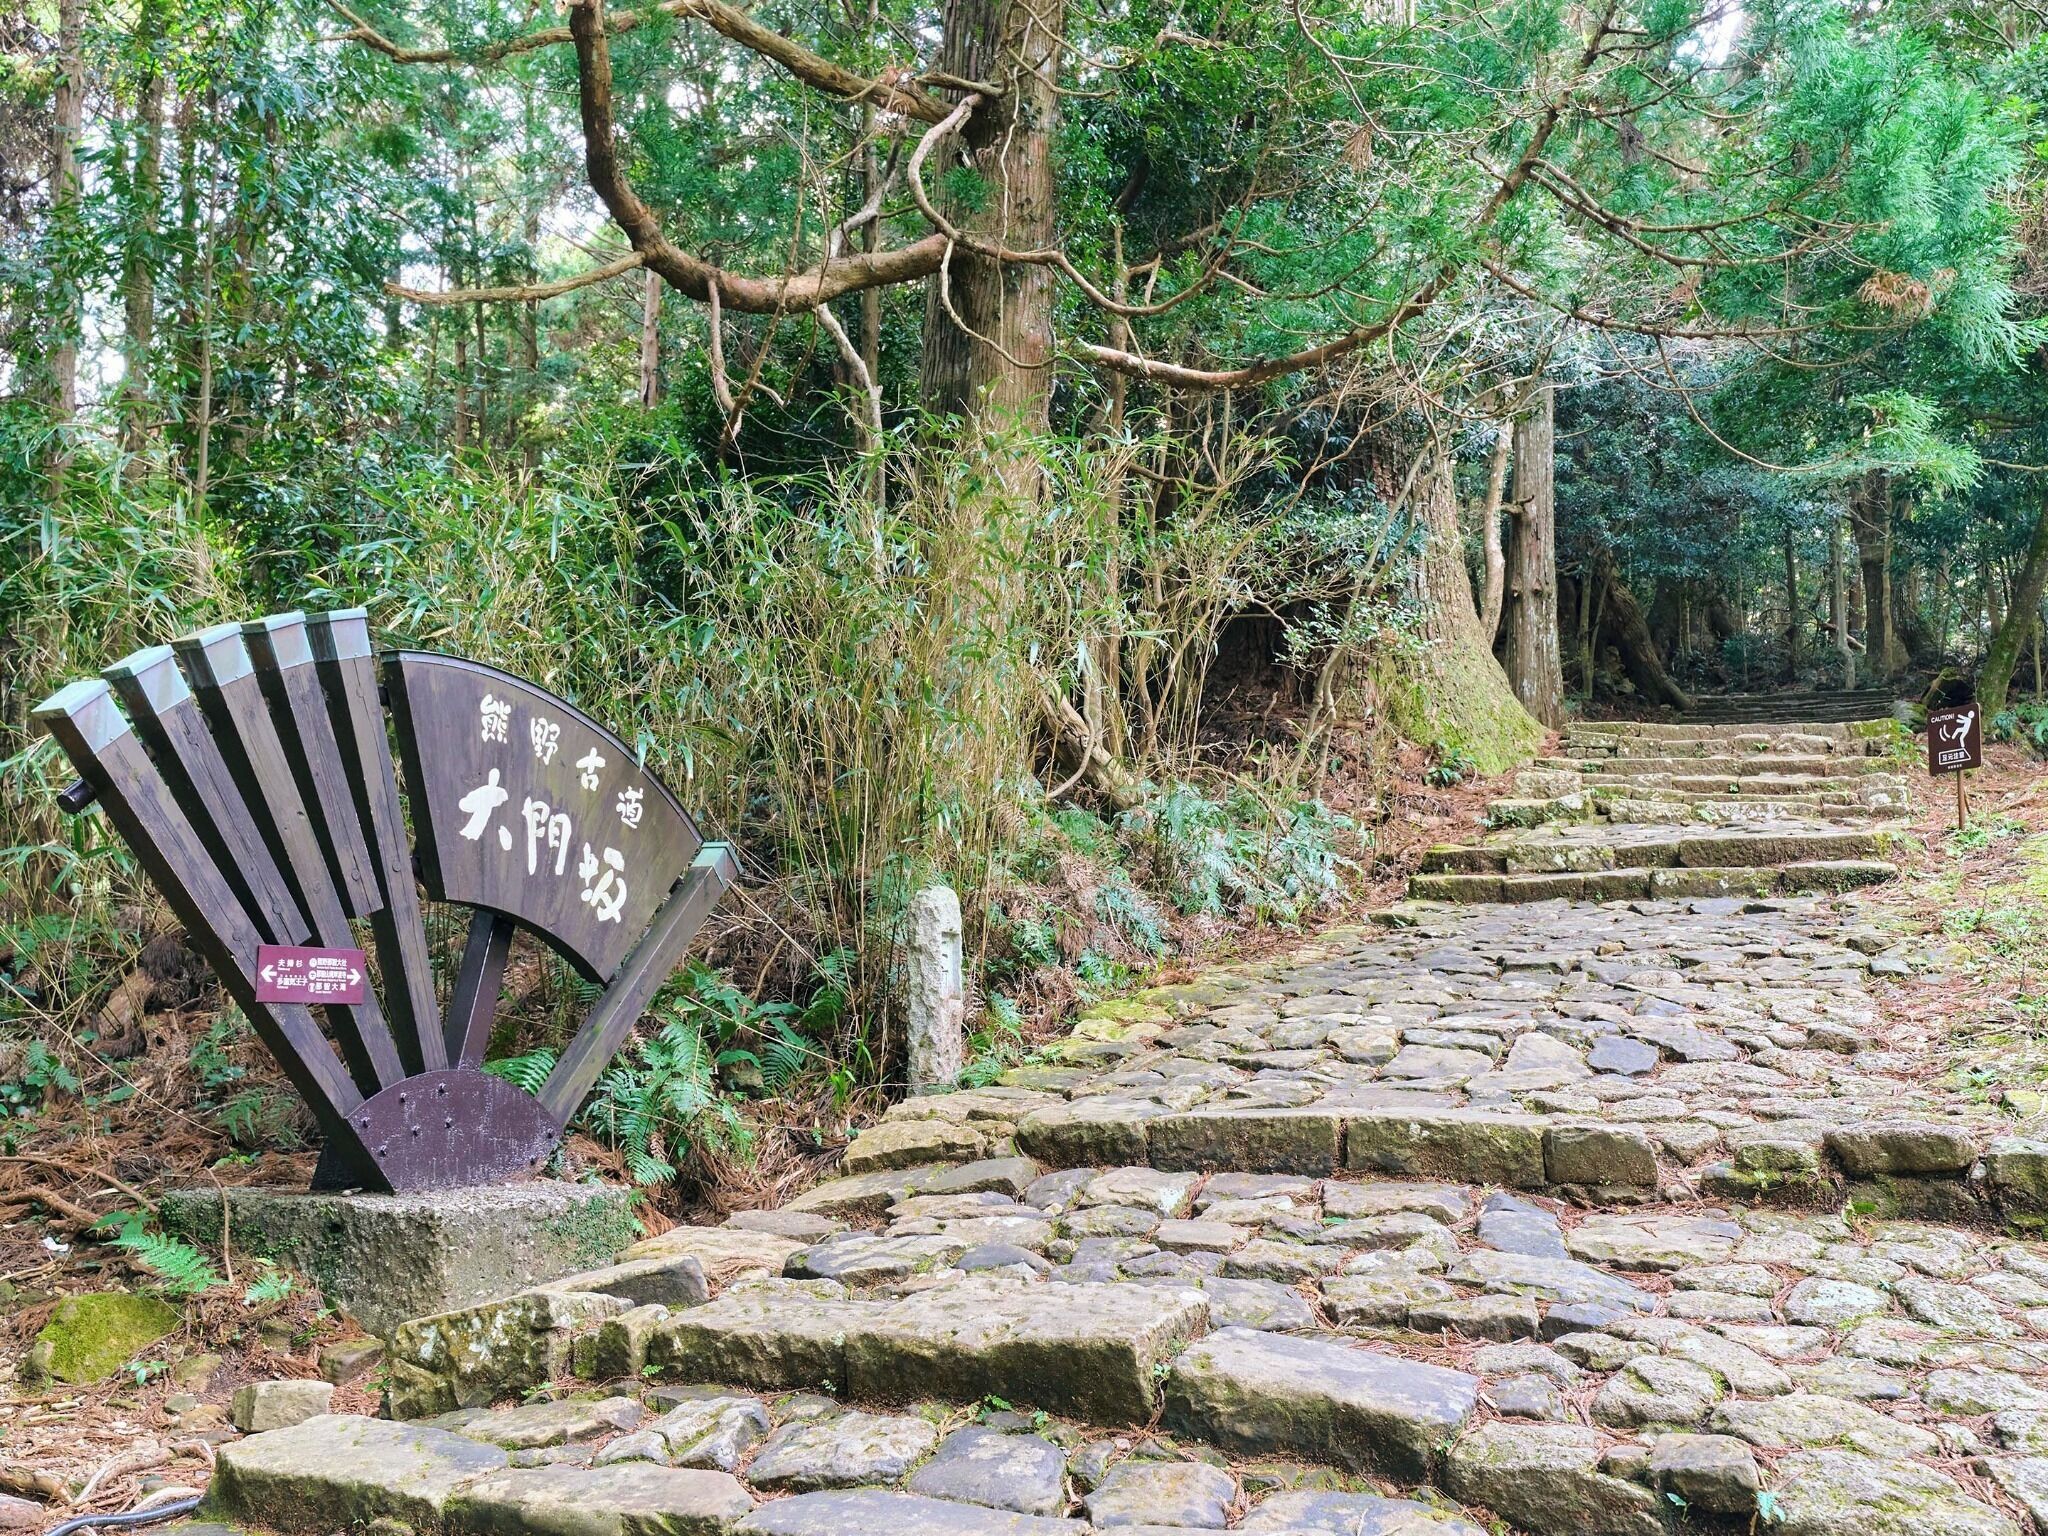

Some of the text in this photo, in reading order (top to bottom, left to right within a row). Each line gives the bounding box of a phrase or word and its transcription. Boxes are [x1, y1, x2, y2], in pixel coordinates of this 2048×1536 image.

[480, 694, 643, 829] 熊野古道
[458, 768, 627, 923] 大門坂
